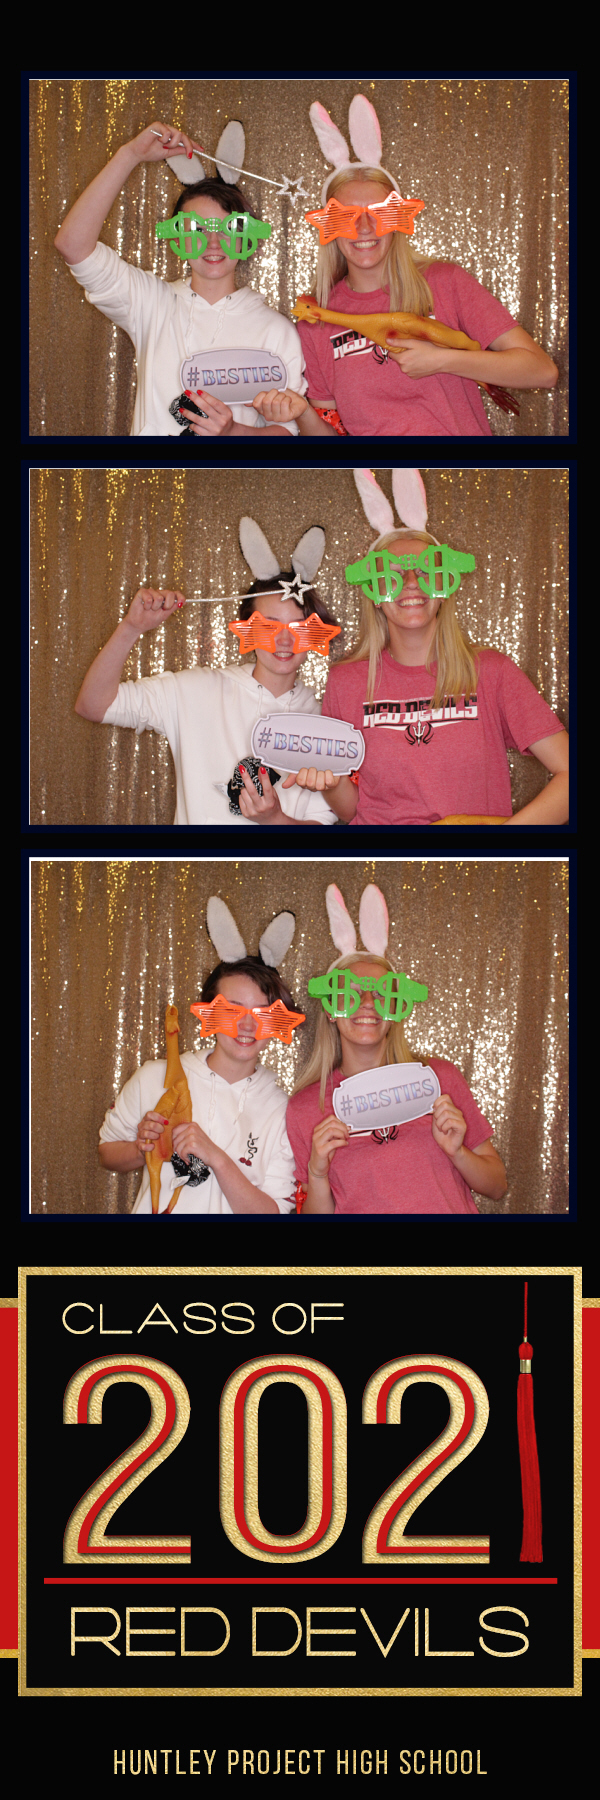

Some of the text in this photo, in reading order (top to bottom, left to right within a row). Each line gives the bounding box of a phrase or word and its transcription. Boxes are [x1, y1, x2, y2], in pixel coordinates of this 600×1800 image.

[187, 365, 283, 387] #BESTIES
[362, 696, 478, 727] RED DEVILS
[258, 728, 358, 759] #BESTIES
[340, 1079, 434, 1116] #BESTIES
